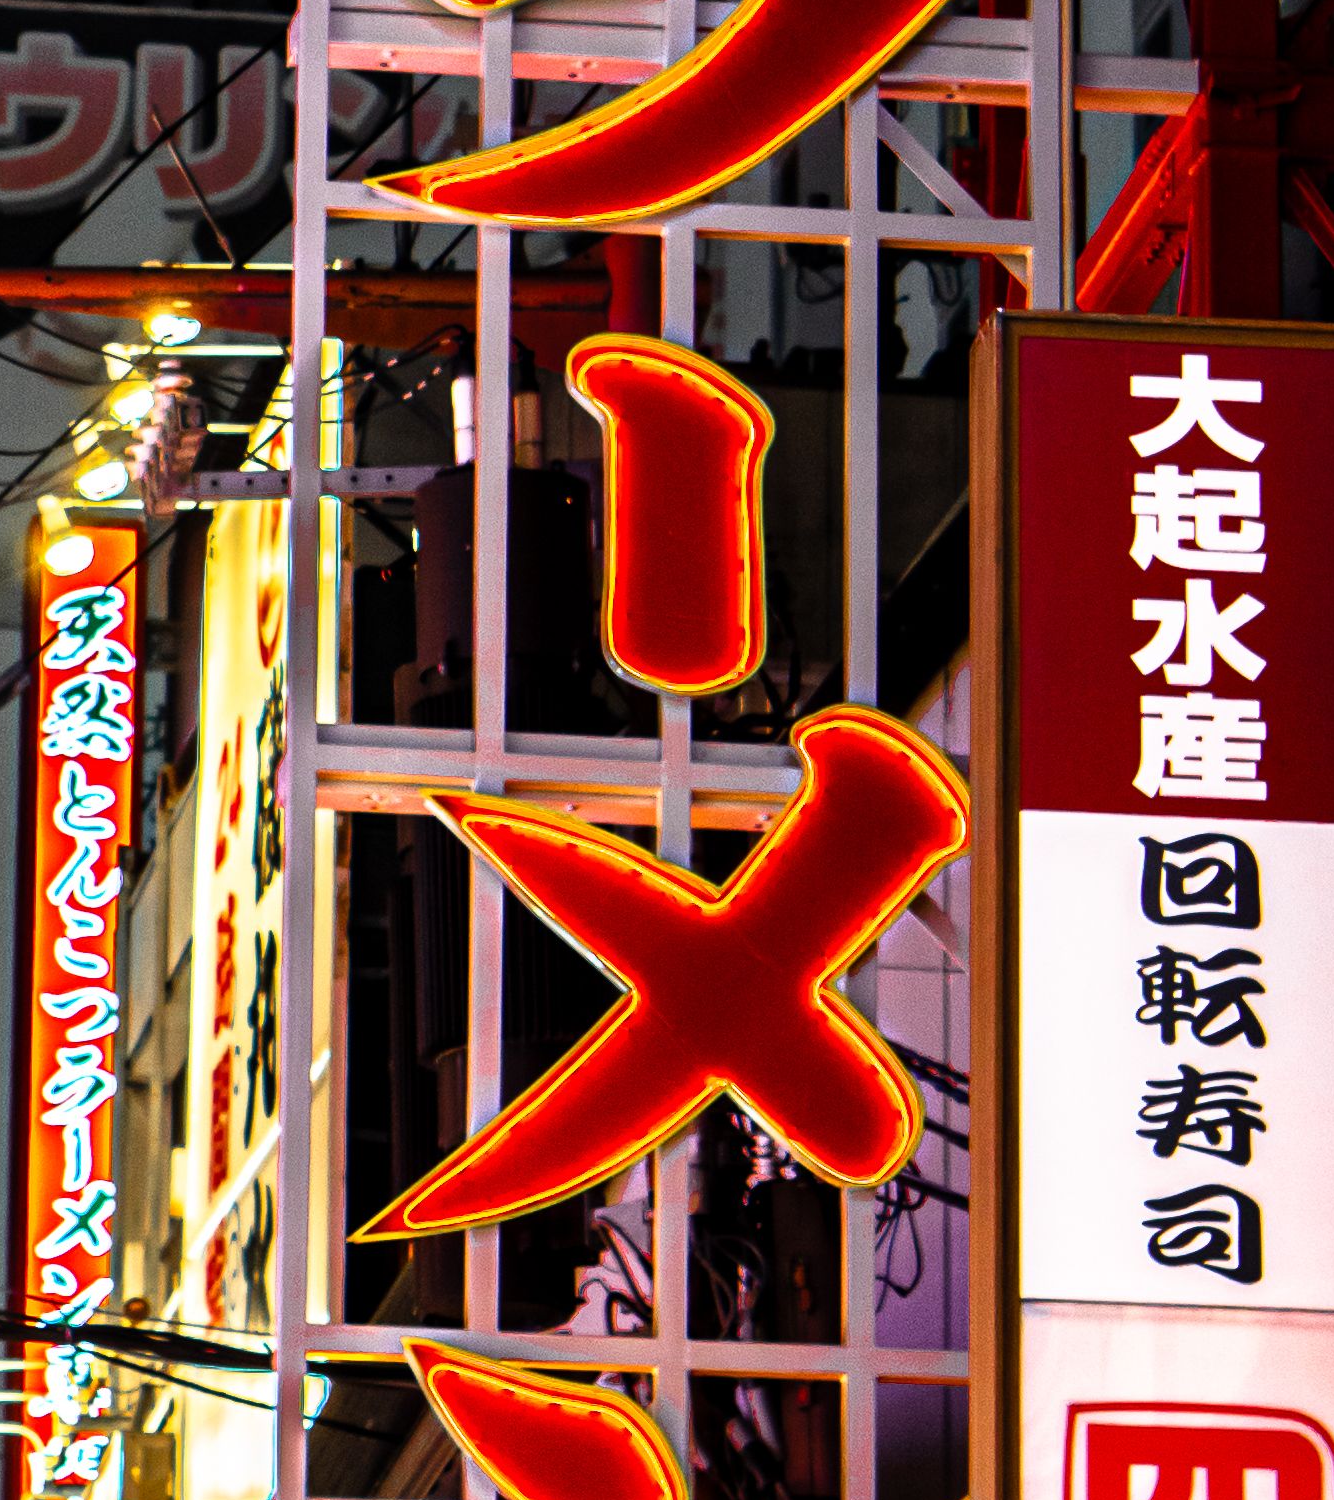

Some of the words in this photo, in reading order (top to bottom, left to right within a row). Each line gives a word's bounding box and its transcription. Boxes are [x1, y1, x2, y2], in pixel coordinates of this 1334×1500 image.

[1128, 353, 1269, 803] 大起水産
[1134, 831, 1269, 1285] 回転寿司
